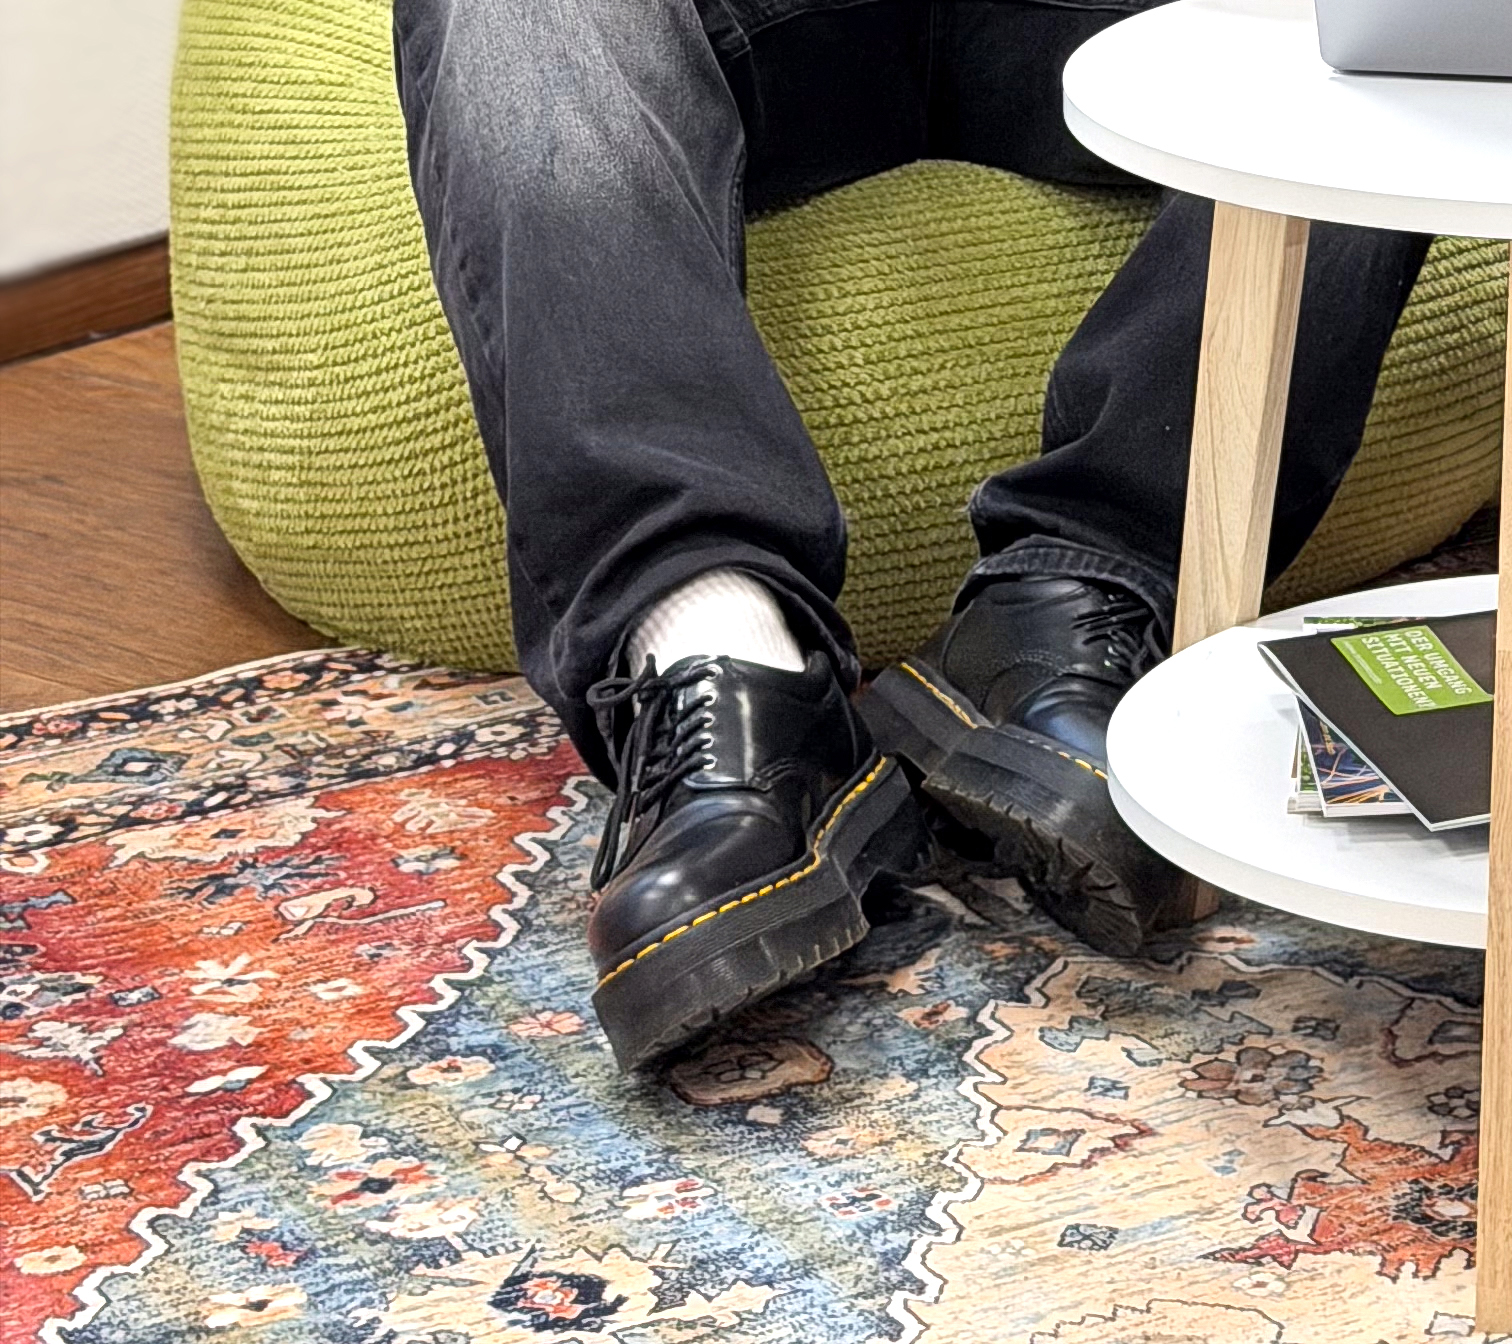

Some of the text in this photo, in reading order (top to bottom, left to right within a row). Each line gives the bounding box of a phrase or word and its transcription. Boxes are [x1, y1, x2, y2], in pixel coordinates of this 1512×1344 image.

[1383, 633, 1443, 690] MIT NEUEN
[1404, 629, 1472, 695] DER UMGANG
